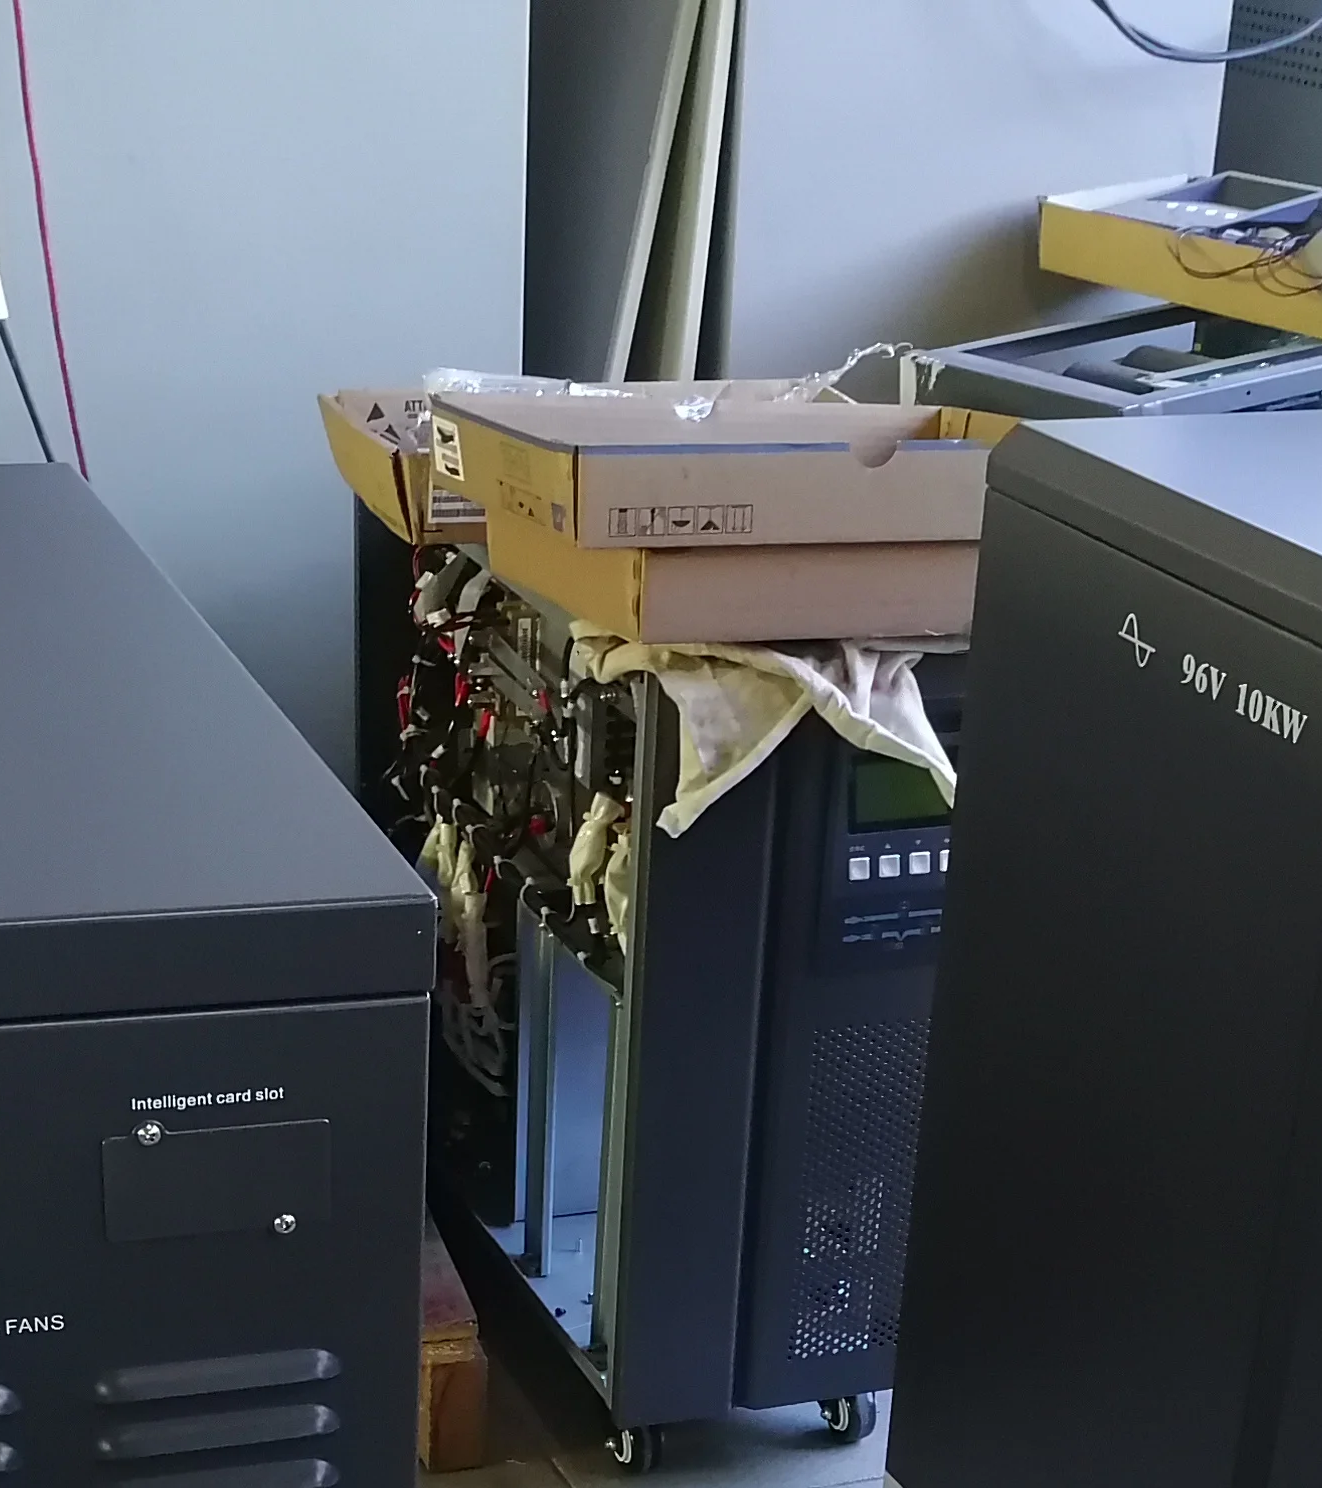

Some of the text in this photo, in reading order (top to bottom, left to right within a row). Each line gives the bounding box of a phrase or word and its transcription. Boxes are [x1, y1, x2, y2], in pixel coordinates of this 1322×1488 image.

[1180, 654, 1308, 744] 96V 10KW
[131, 1086, 284, 1111] Intelligent card slot
[5, 1314, 65, 1335] FANS
